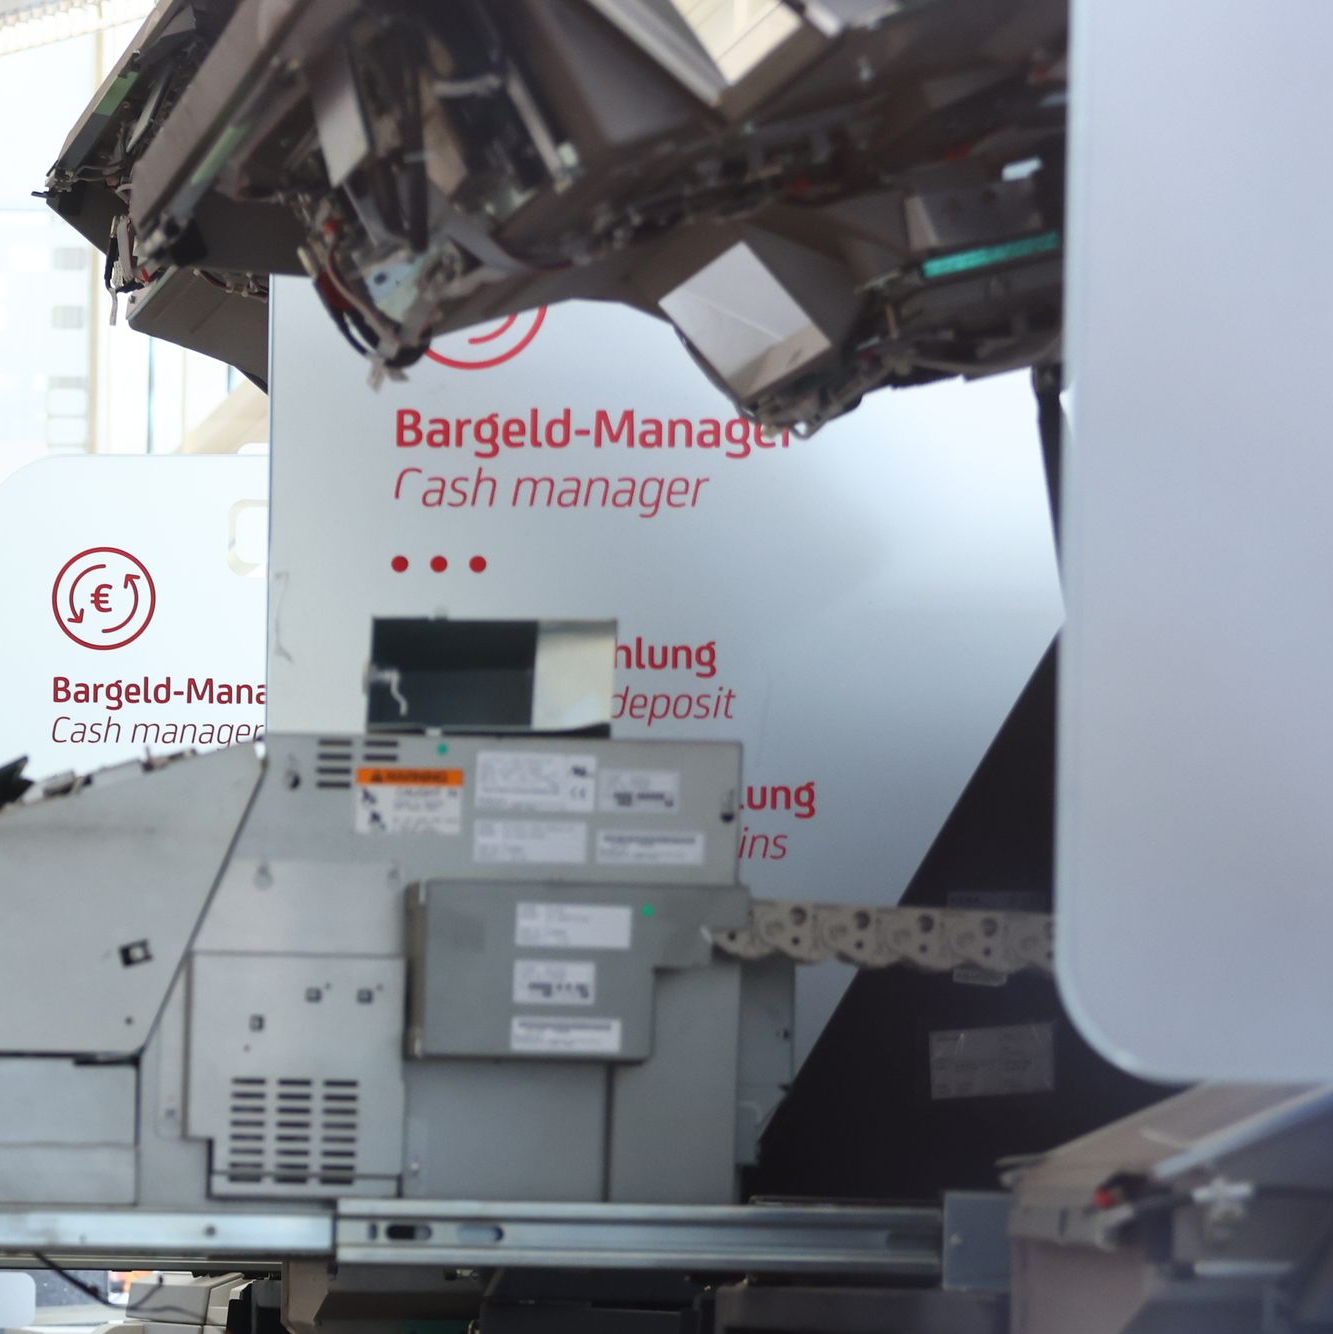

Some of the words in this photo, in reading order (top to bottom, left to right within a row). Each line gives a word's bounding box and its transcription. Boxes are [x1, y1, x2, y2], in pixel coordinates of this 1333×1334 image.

[511, 475, 710, 518] manager
[51, 716, 121, 744] Cash
[131, 722, 264, 747] manager
